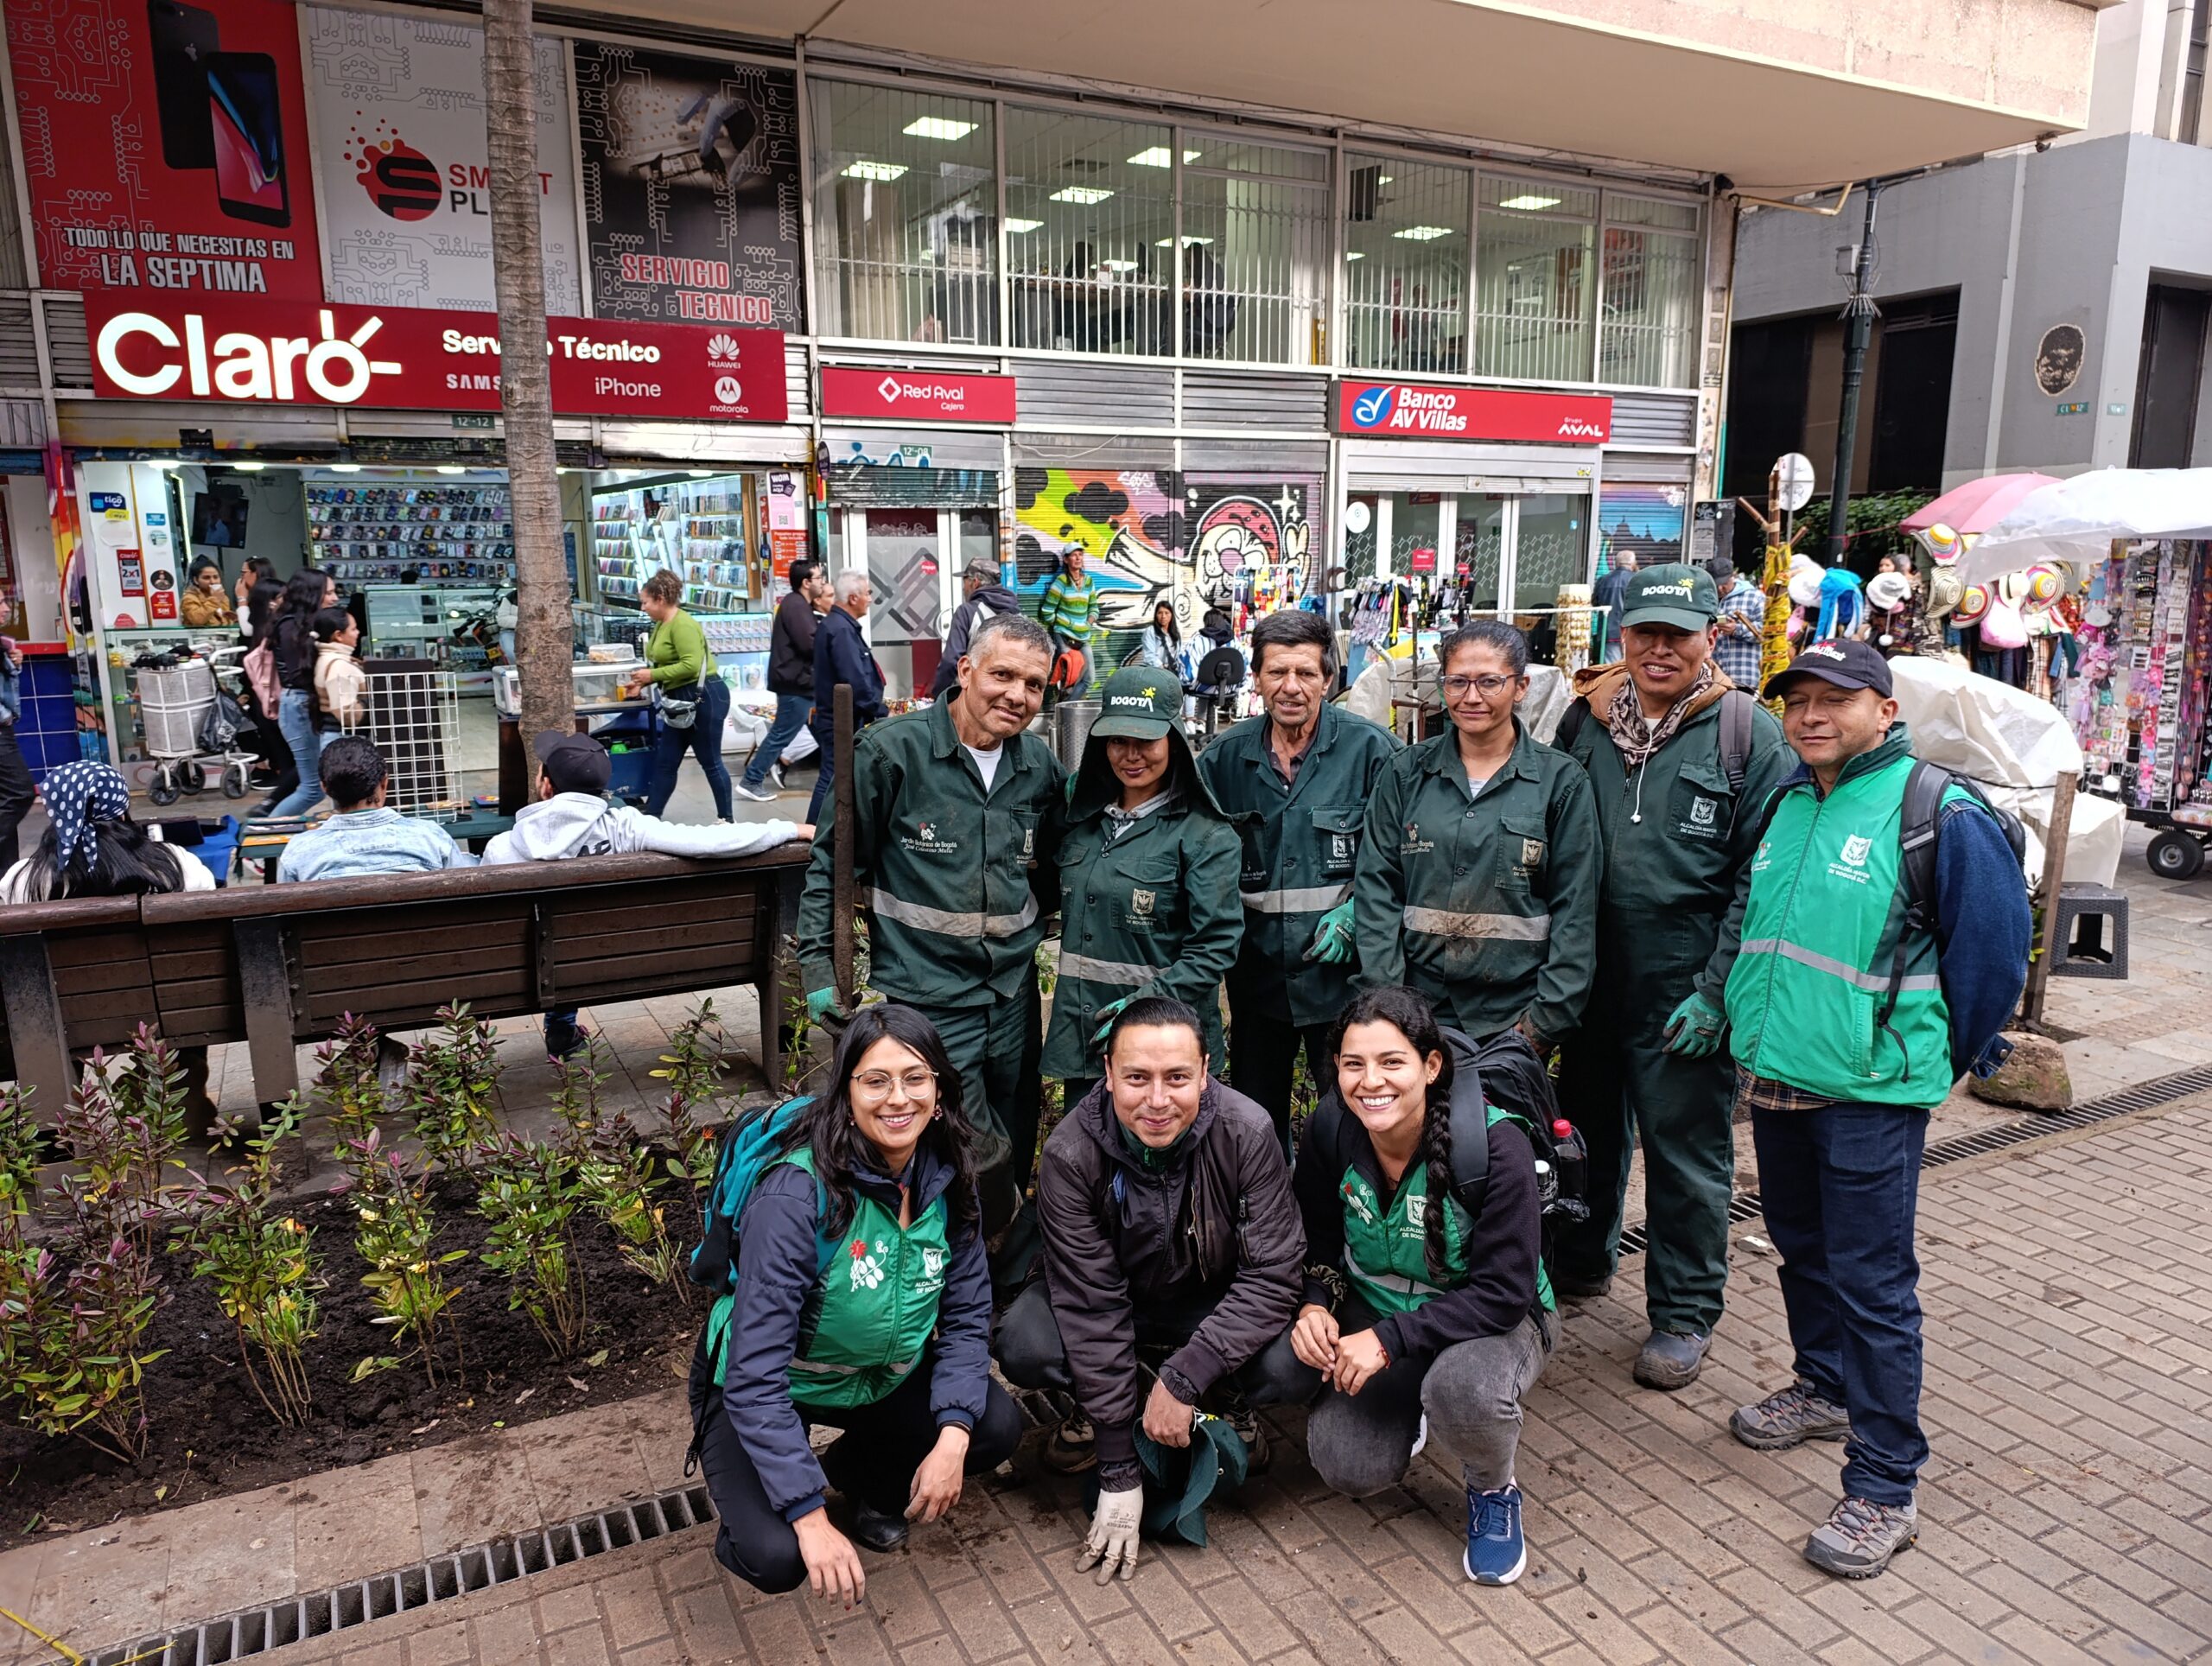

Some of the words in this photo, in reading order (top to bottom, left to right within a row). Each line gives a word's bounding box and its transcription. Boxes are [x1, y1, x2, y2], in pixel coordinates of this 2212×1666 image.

[449, 164, 553, 195] SMT
[64, 227, 108, 248] TODO
[113, 230, 136, 251] LO
[139, 232, 172, 253] QUE
[176, 234, 267, 258] NECESITAS
[272, 240, 295, 260] EN
[101, 254, 140, 287] LA
[146, 257, 267, 294] SEPTIMA
[620, 252, 730, 289] SERVICIO
[675, 289, 772, 324] TECNICO
[97, 311, 375, 403] Claro
[558, 334, 662, 364] Técnico
[708, 360, 741, 369] HUAWEI
[594, 377, 662, 397] iPhone
[902, 384, 931, 398] Red
[933, 385, 964, 400] Aval
[940, 403, 964, 411] Cajero
[1397, 387, 1456, 410] Banco
[709, 404, 749, 414] motorola
[1389, 410, 1417, 428] AV
[1418, 410, 1467, 431] Villas
[1557, 424, 1604, 436] AVAL
[771, 474, 790, 483] WOM
[122, 569, 141, 577] 2x1
[1400, 1226, 1425, 1235] ALCALDÍA
